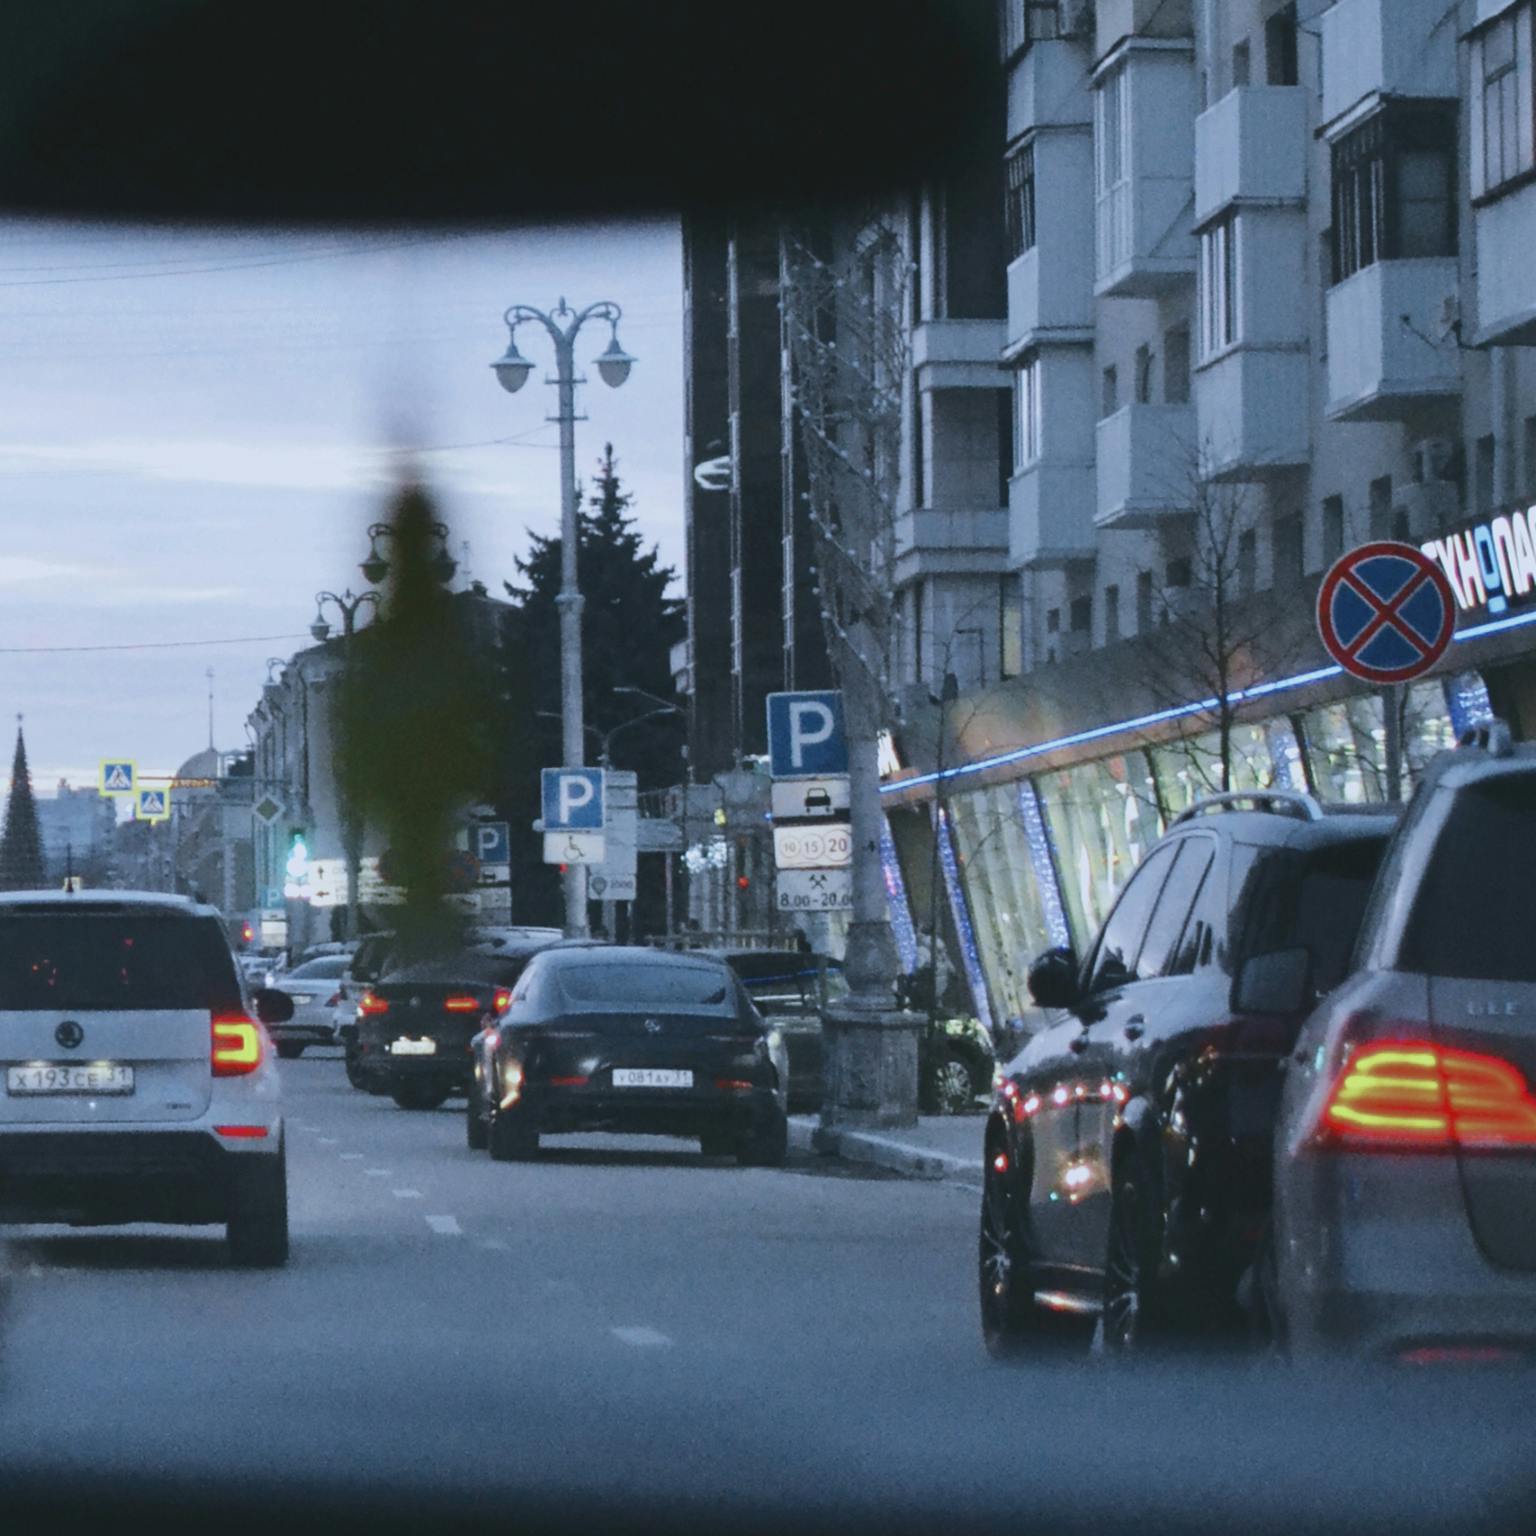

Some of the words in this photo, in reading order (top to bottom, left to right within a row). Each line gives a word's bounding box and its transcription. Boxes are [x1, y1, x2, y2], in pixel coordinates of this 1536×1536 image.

[1421, 504, 1536, 611] ХНОПА
[789, 700, 834, 767] P
[559, 775, 594, 824] P
[478, 827, 500, 860] P
[804, 840, 818, 853] 15
[828, 837, 848, 853] 20
